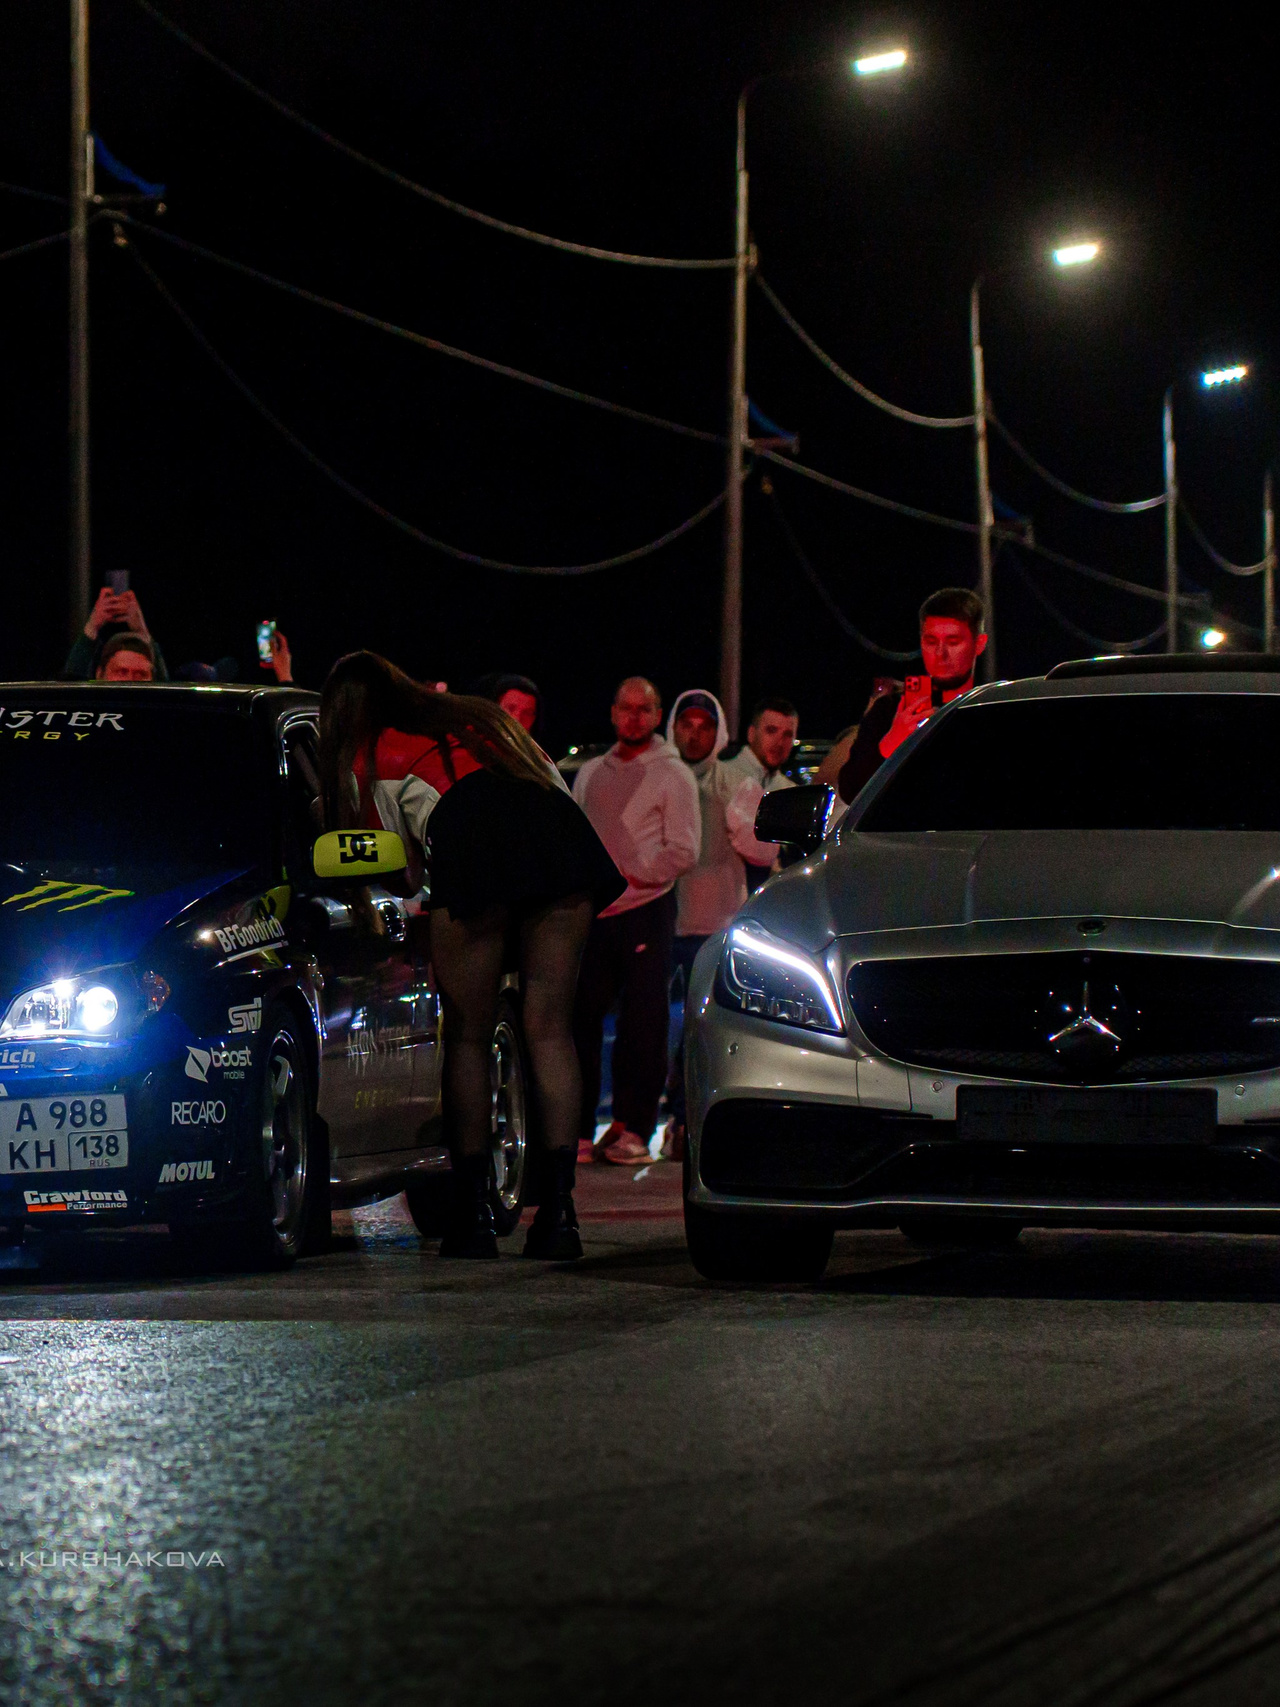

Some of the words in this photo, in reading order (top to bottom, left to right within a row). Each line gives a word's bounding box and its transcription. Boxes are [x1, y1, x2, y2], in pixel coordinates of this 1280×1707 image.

[214, 915, 286, 953] BFGoodrich
[210, 1046, 253, 1068] boost
[223, 1070, 245, 1080] mobile
[16, 1102, 38, 1132] A
[49, 1099, 108, 1129] 988
[171, 1100, 226, 1125] RECARO
[8, 1139, 56, 1170] KH
[75, 1134, 120, 1159] 138
[89, 1158, 111, 1168] RUS
[158, 1160, 215, 1183] MOTUL
[23, 1189, 128, 1205] Crawford
[66, 1201, 128, 1210] Performance
